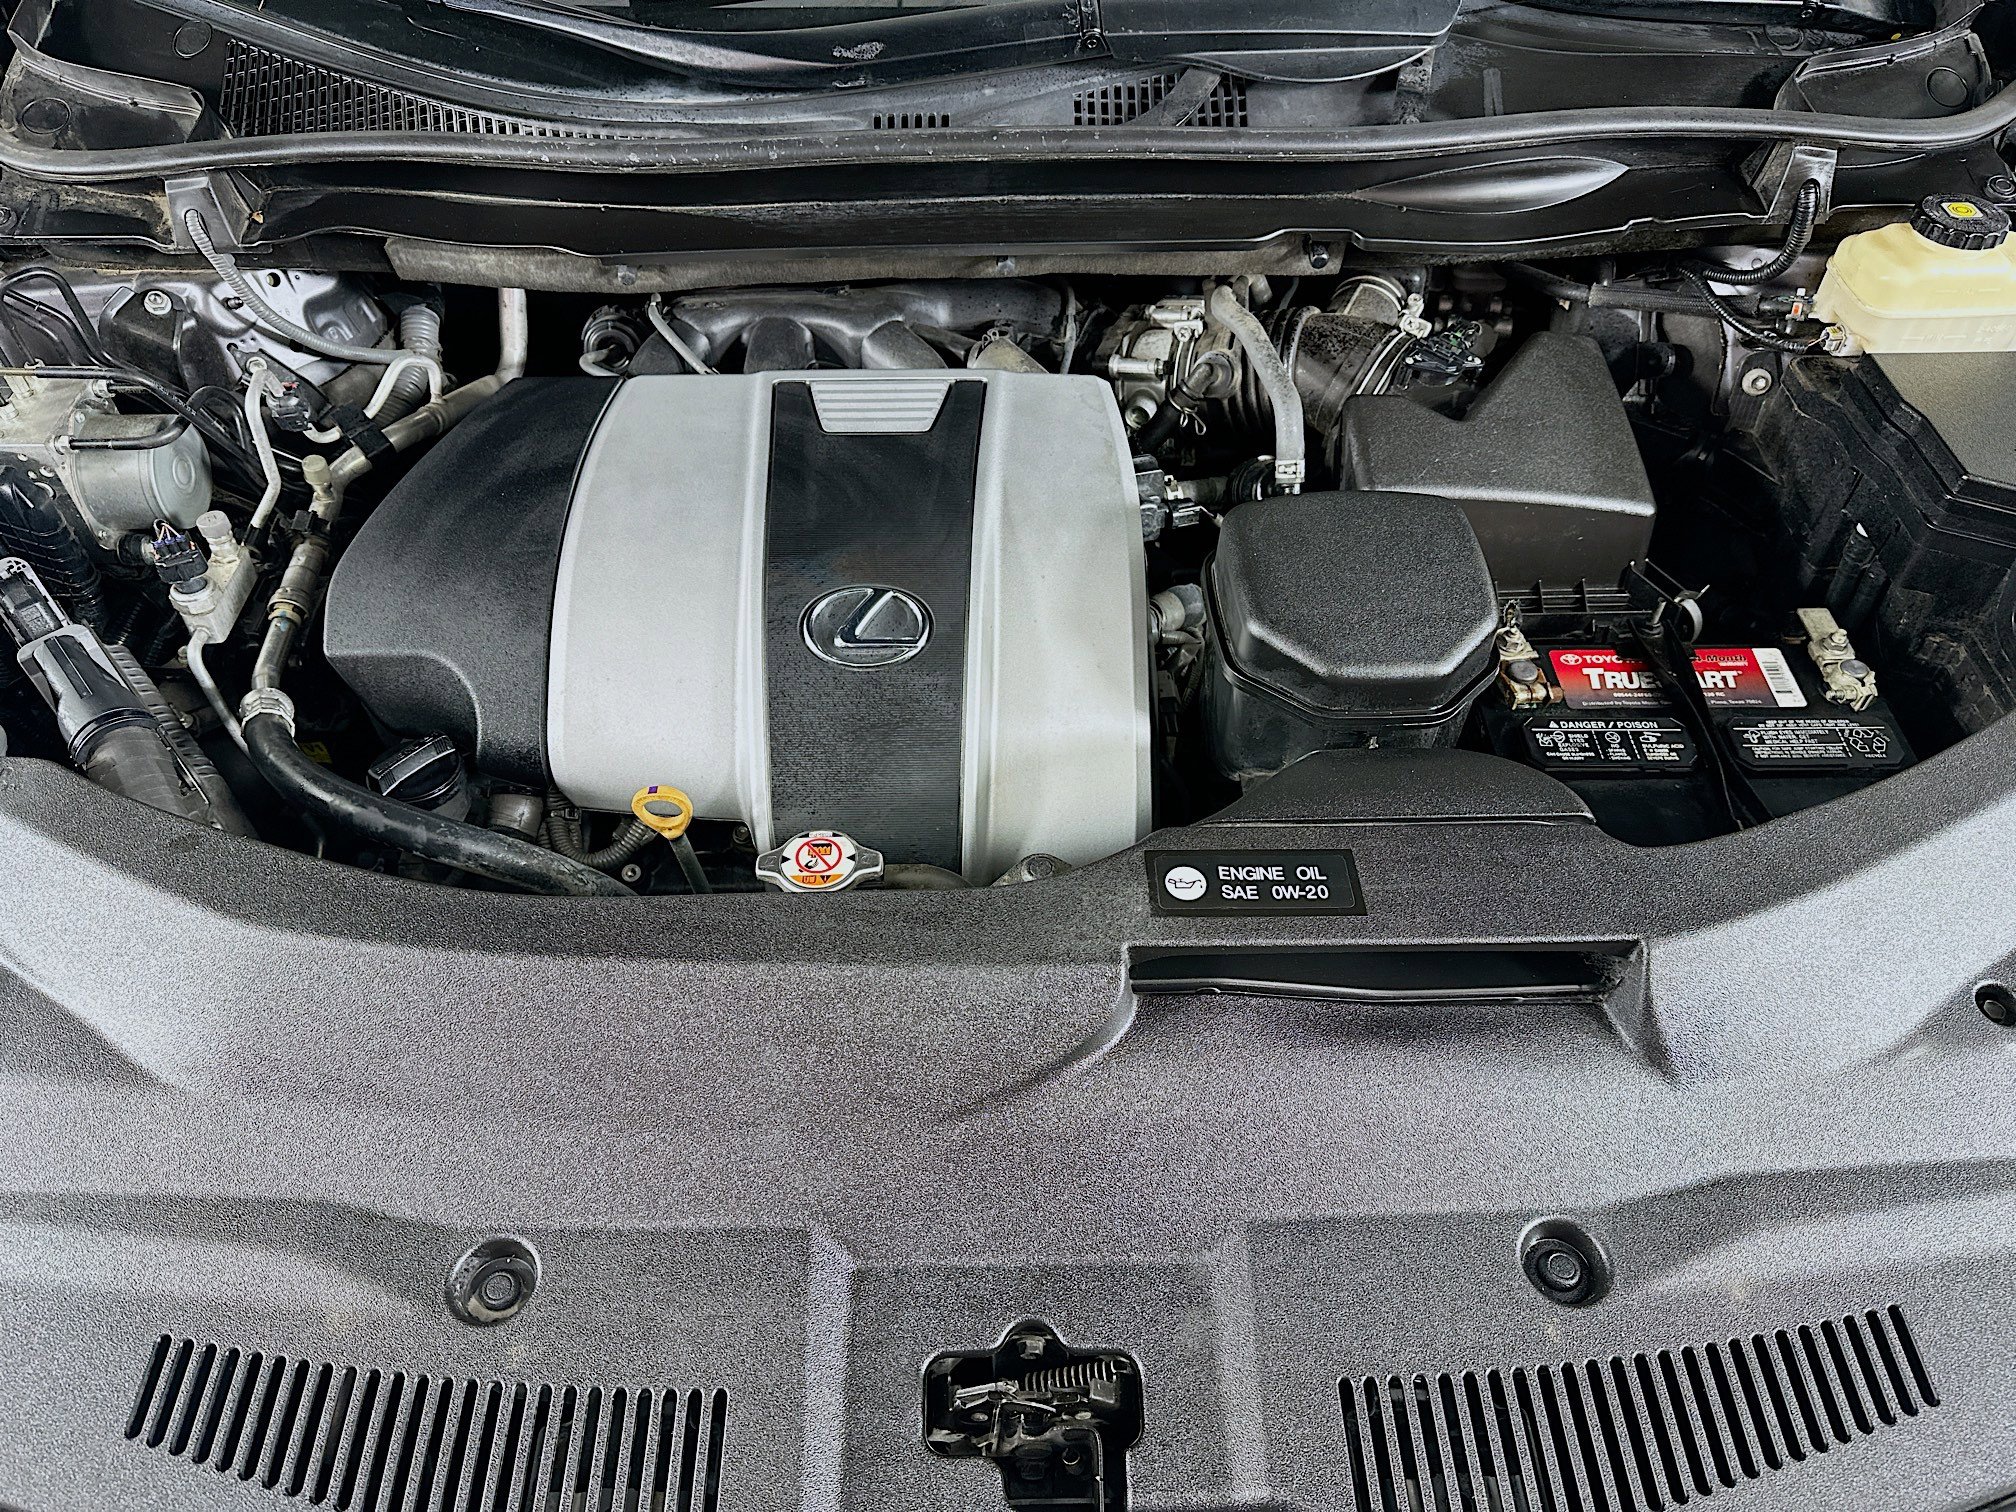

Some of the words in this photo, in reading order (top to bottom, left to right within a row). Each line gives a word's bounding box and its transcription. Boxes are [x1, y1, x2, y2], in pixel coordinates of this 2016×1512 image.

[1560, 721, 1606, 729] DANGER
[1617, 721, 1658, 729] POISON
[1218, 866, 1285, 881] ENGINE
[1296, 866, 1328, 881] OIL
[1221, 885, 1259, 900] SAE
[1271, 885, 1329, 900] 0W-20
